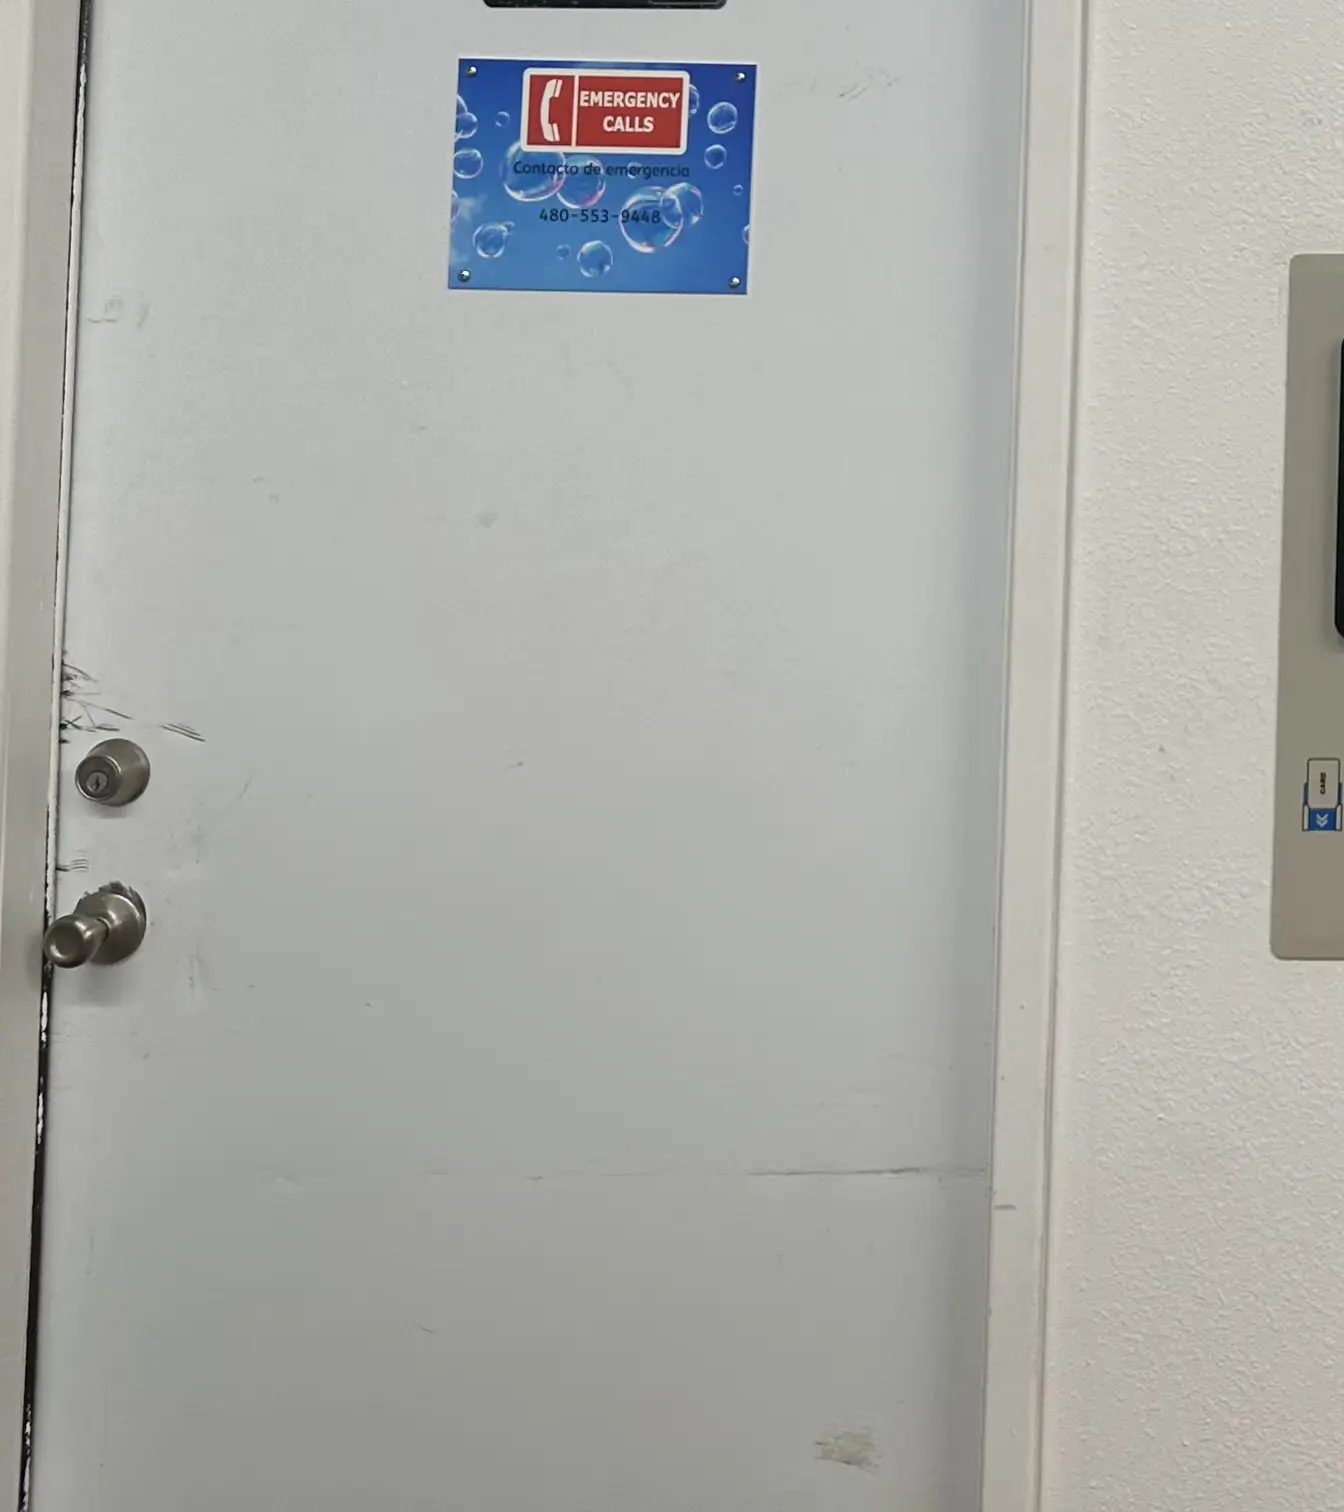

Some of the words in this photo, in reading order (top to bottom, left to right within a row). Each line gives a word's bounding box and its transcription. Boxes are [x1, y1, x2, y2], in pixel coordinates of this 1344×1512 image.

[579, 90, 680, 108] EMERGENCY
[602, 115, 654, 132] CALLS
[512, 161, 580, 176] Contacto
[582, 162, 602, 176] de
[606, 165, 690, 180] emergencia
[538, 208, 661, 224] 480-553-9448
